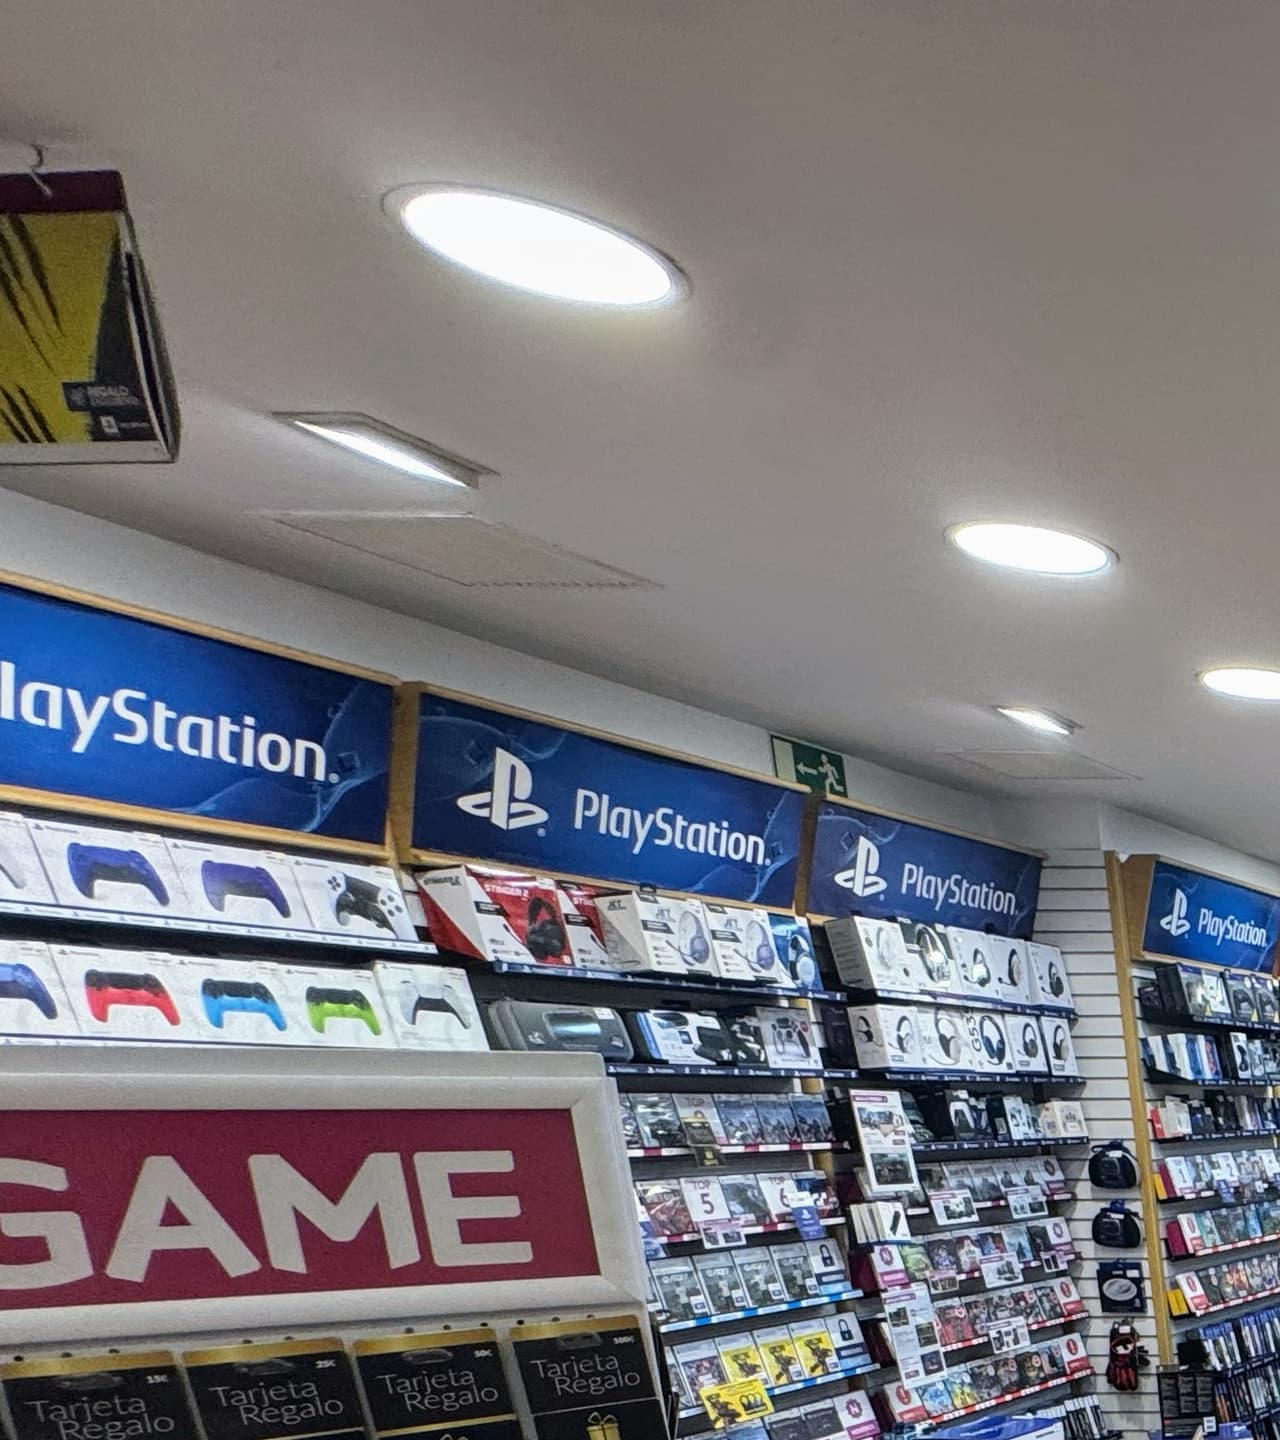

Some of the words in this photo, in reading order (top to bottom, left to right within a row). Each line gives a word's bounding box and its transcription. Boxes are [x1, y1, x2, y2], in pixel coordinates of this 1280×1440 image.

[0, 660, 328, 783] layStation
[700, 1191, 716, 1214] 5
[0, 1149, 534, 1290] GAME
[377, 1365, 476, 1395] Tarjeta
[530, 1352, 619, 1380] Tarjeta
[553, 1366, 642, 1396] Regalo
[210, 1376, 319, 1409] Tarjeta
[403, 1382, 499, 1412] Regalo
[240, 1394, 344, 1426] Regalo
